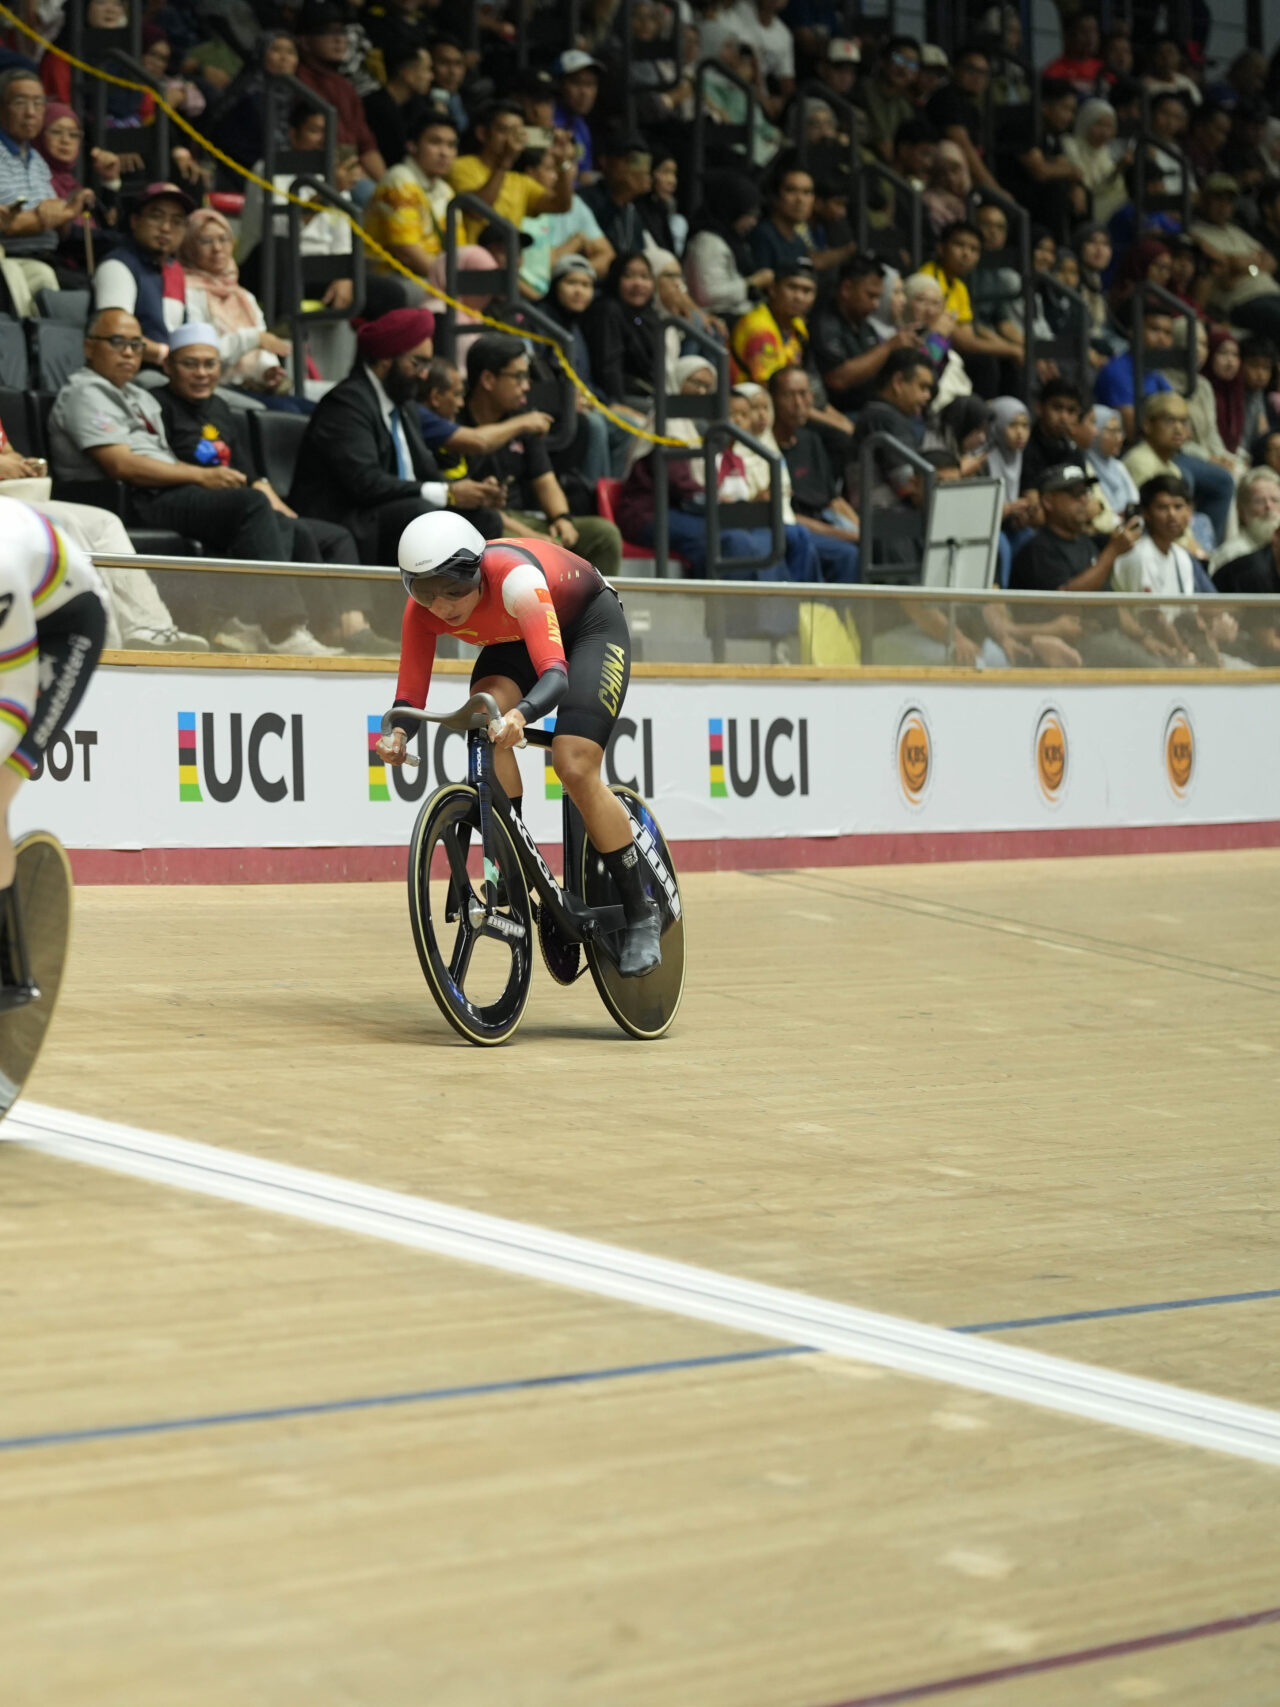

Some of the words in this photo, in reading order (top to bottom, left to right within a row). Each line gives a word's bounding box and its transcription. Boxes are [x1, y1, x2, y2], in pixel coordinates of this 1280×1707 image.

[598, 642, 625, 718] CHINA
[202, 712, 305, 803] UCI
[392, 714, 468, 802] UC
[728, 718, 809, 798] UCI
[509, 804, 563, 907] KOGA
